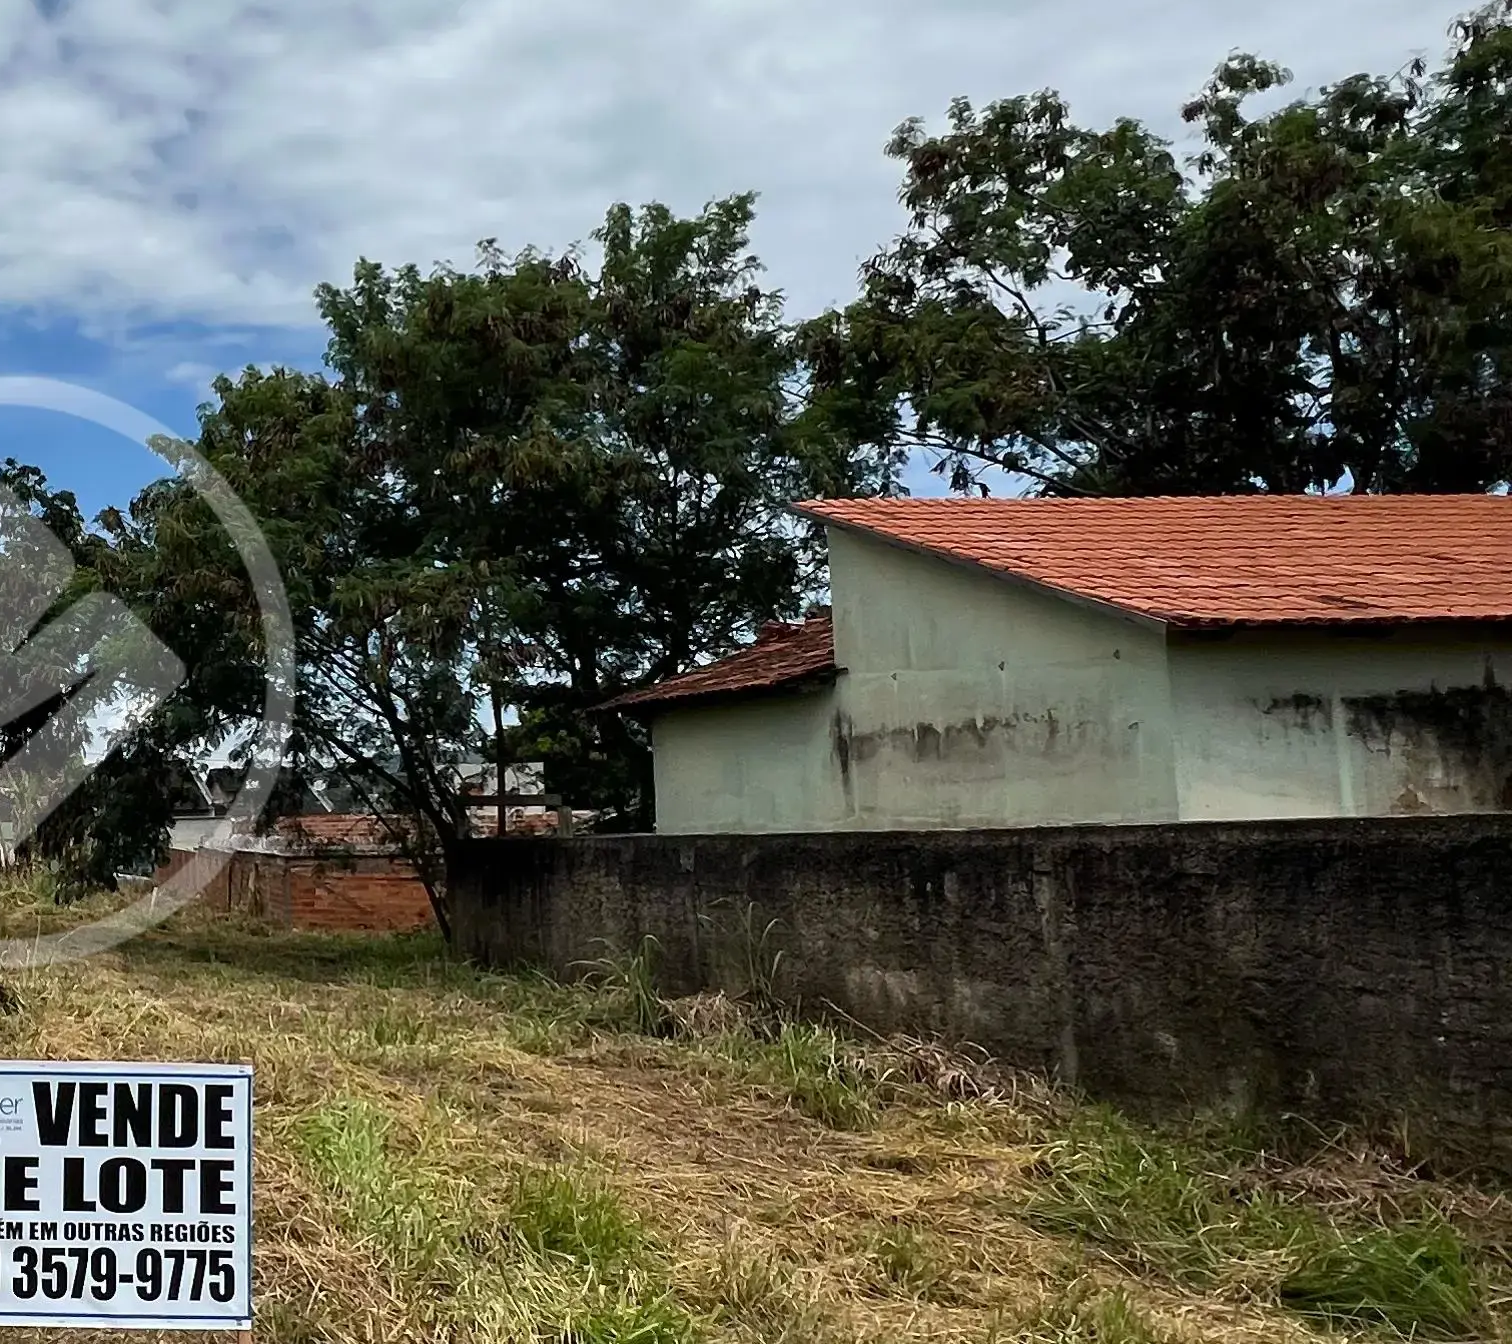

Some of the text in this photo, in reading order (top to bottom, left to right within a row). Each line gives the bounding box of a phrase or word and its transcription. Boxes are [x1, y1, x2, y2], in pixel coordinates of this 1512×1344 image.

[32, 1081, 235, 1149] VENDE
[63, 1156, 237, 1215] LOTE
[29, 1221, 58, 1241] EM
[63, 1222, 144, 1242] OUTRAS
[150, 1220, 235, 1244] REGIÕES
[12, 1246, 236, 1303] 3579-9775
